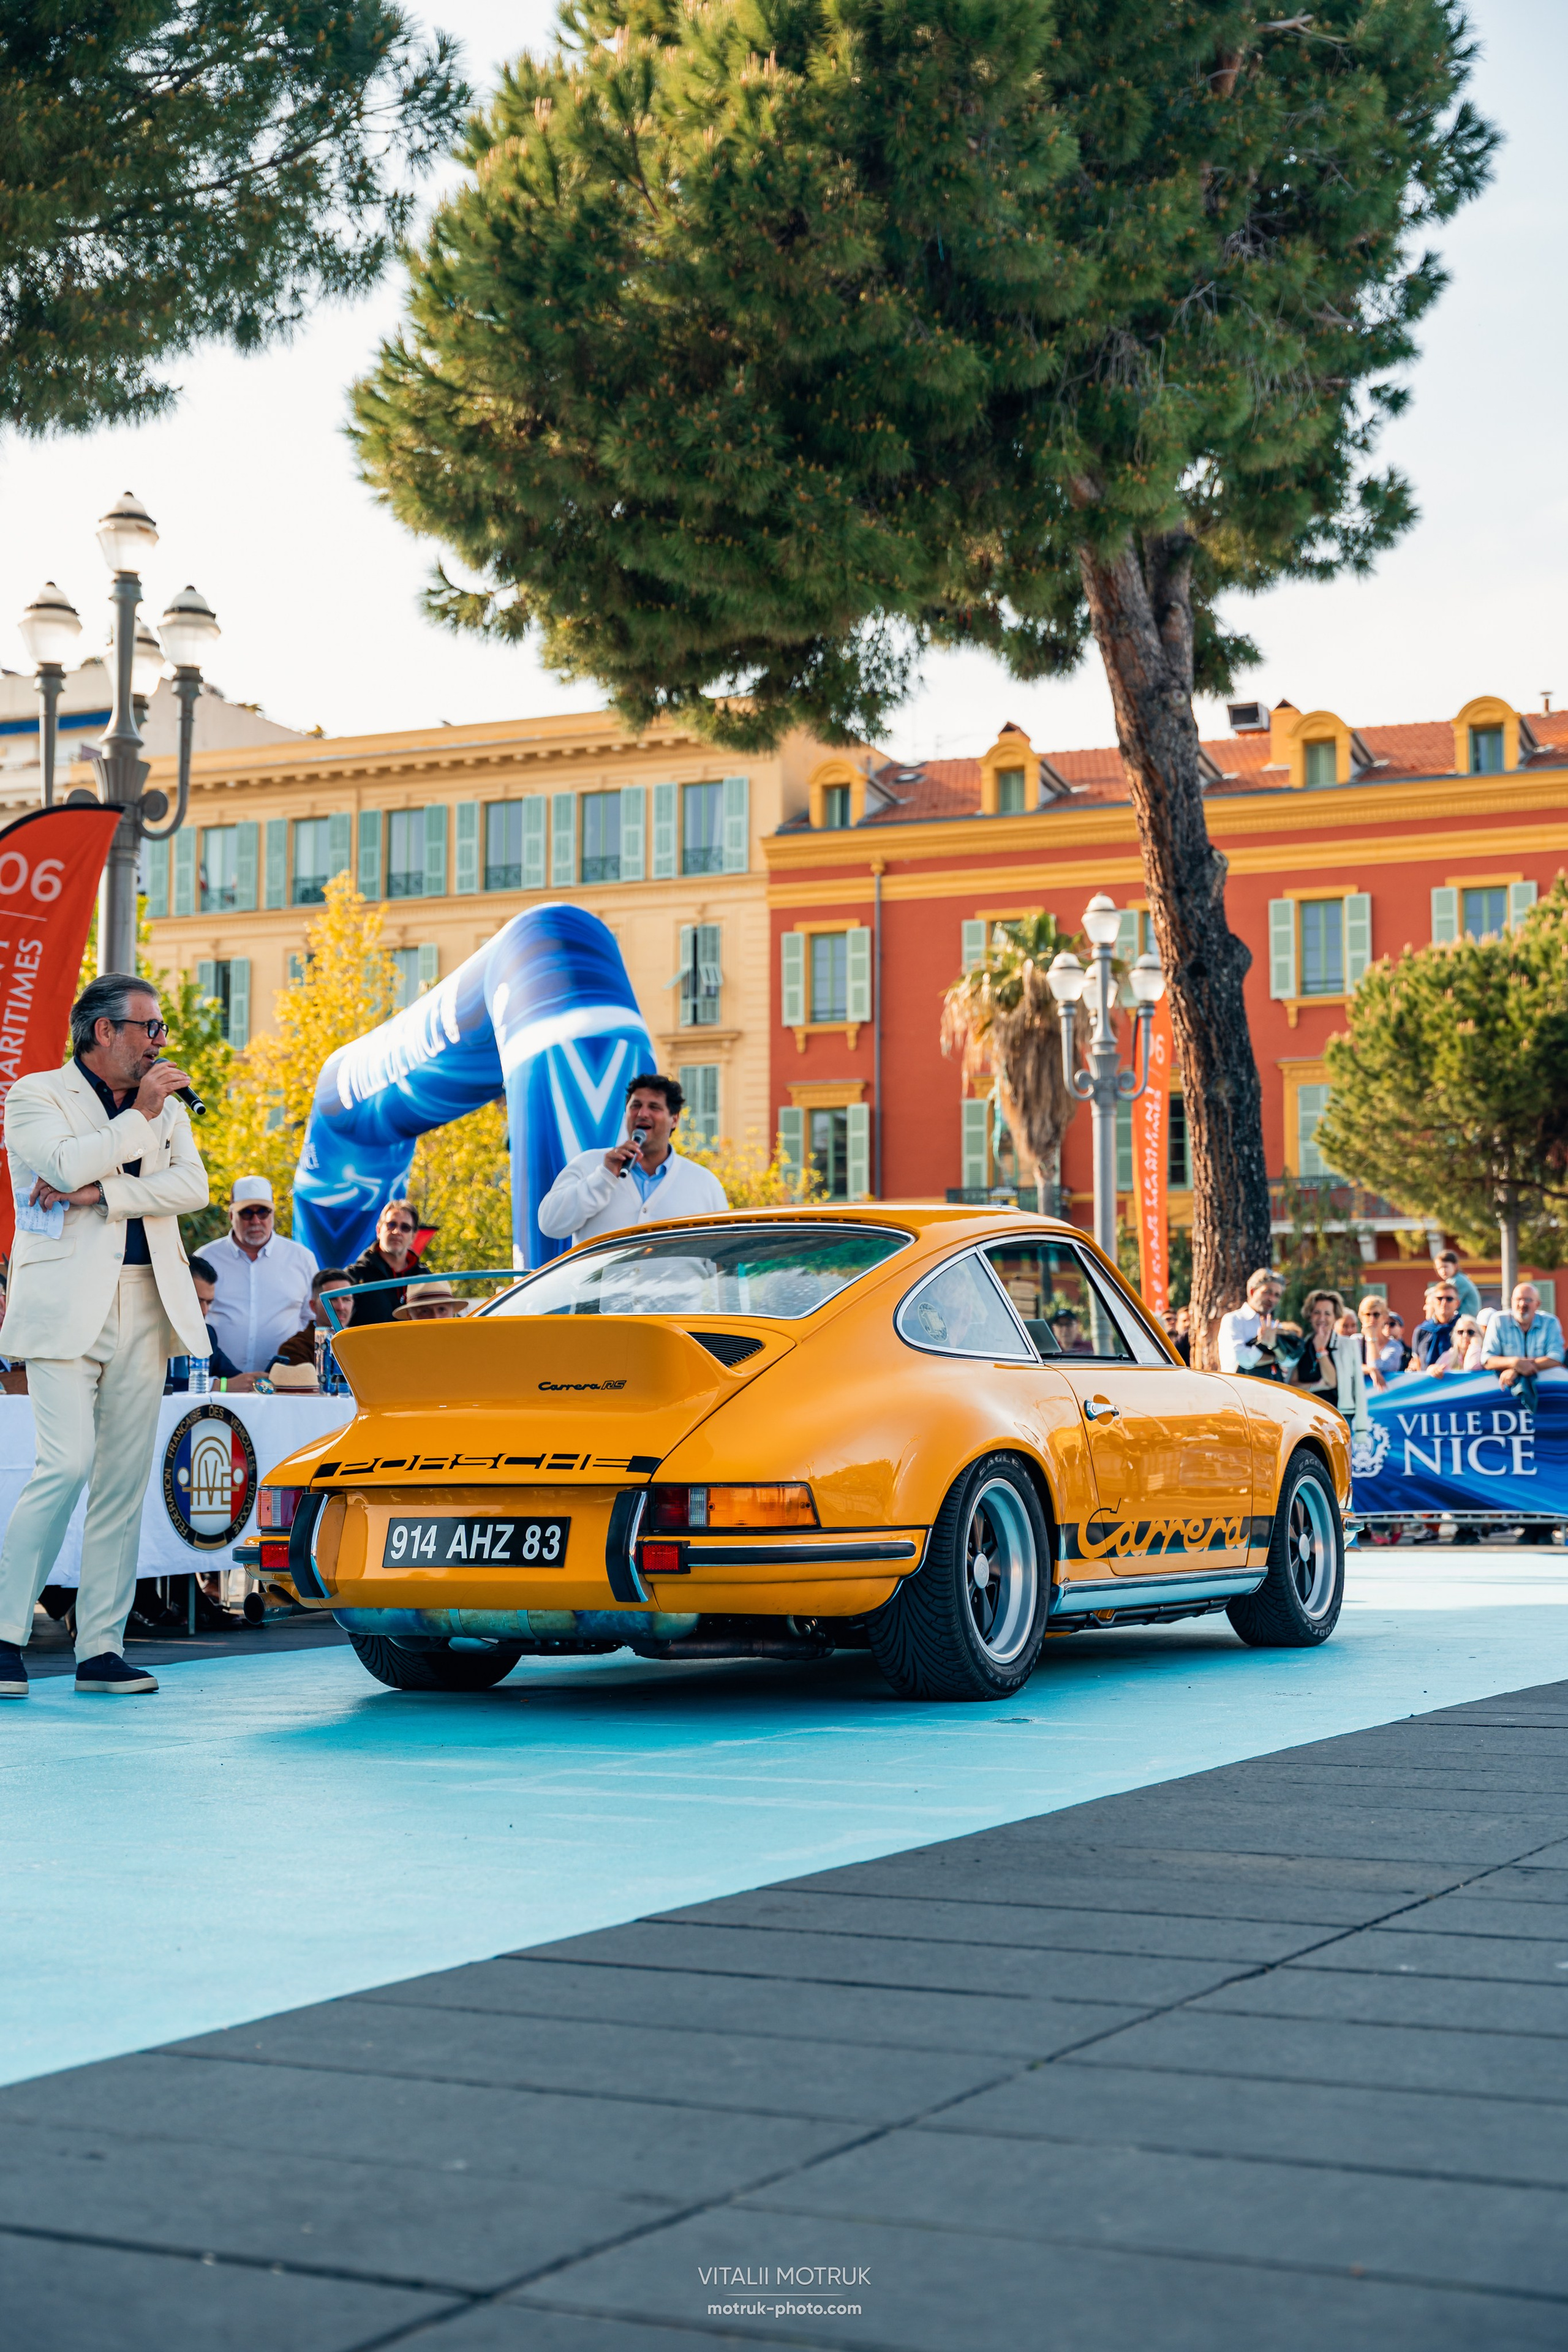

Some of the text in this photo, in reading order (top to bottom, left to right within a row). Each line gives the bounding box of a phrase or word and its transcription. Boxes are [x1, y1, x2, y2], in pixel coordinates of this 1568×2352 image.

[0, 851, 65, 902] 06
[538, 1381, 601, 1391] Carrera
[208, 1407, 224, 1419] DES
[1396, 1409, 1536, 1436] VILLE DE
[334, 1453, 633, 1477] PORSCHE
[979, 1454, 1019, 1478] EAGLE
[1401, 1434, 1538, 1476] NICE
[1077, 1498, 1251, 1559] Carrera
[390, 1525, 562, 1560] 914 AHZ 83
